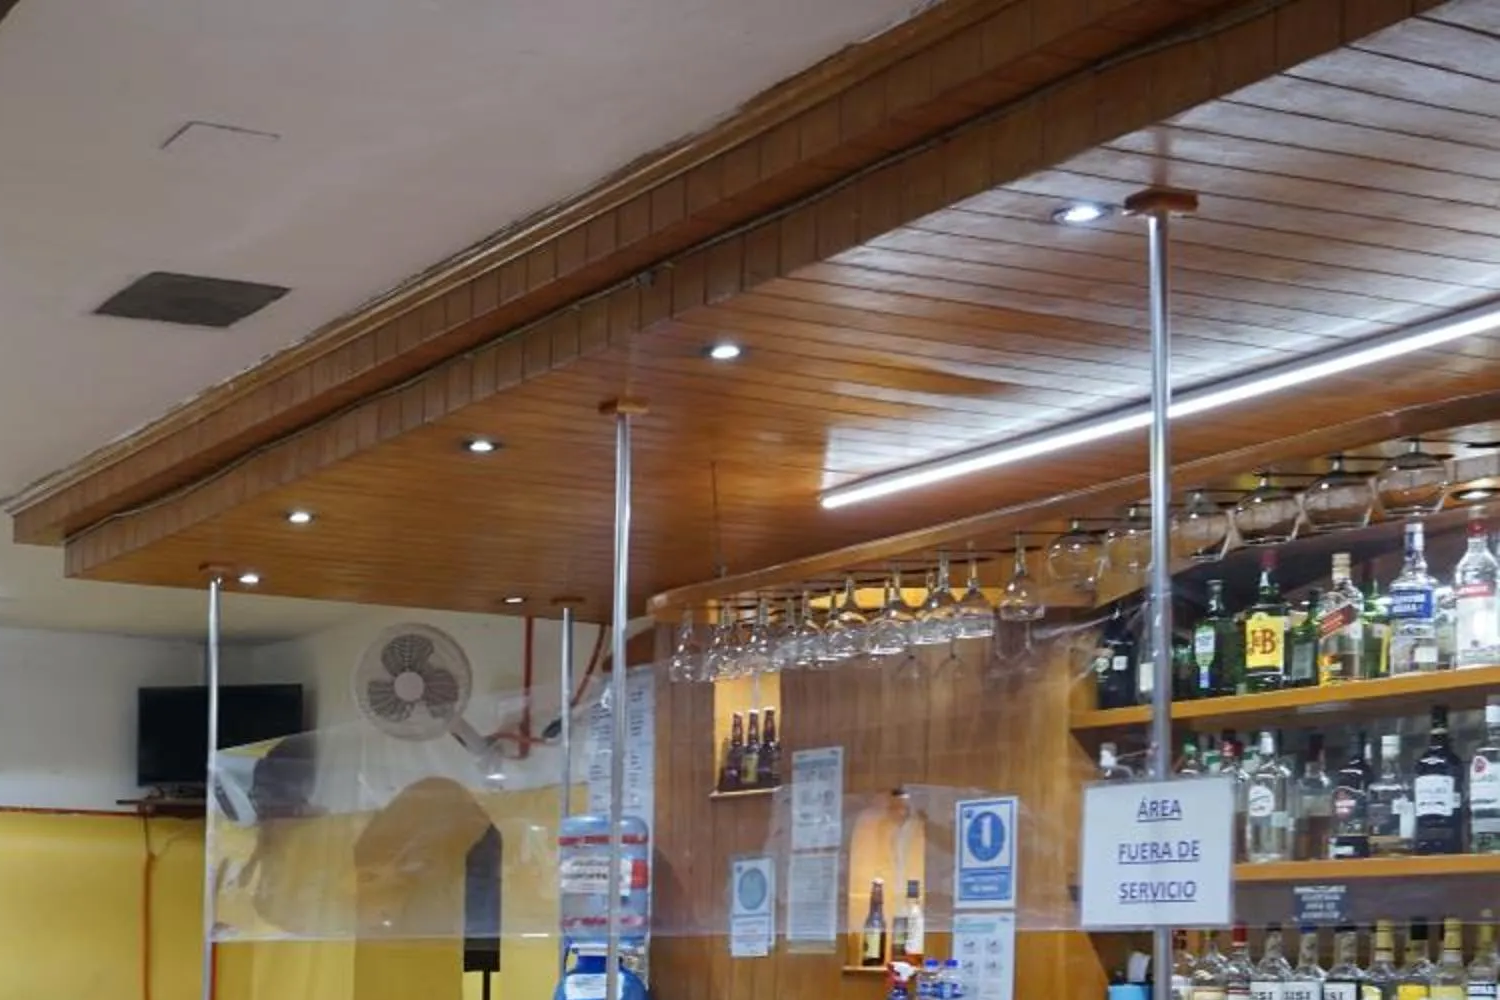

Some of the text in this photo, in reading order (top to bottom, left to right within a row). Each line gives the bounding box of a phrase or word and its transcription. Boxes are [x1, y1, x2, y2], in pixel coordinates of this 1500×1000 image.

[1137, 795, 1182, 818] ÁREA
[1119, 840, 1200, 860] FUERA DE
[1119, 881, 1197, 899] SERVICIO
